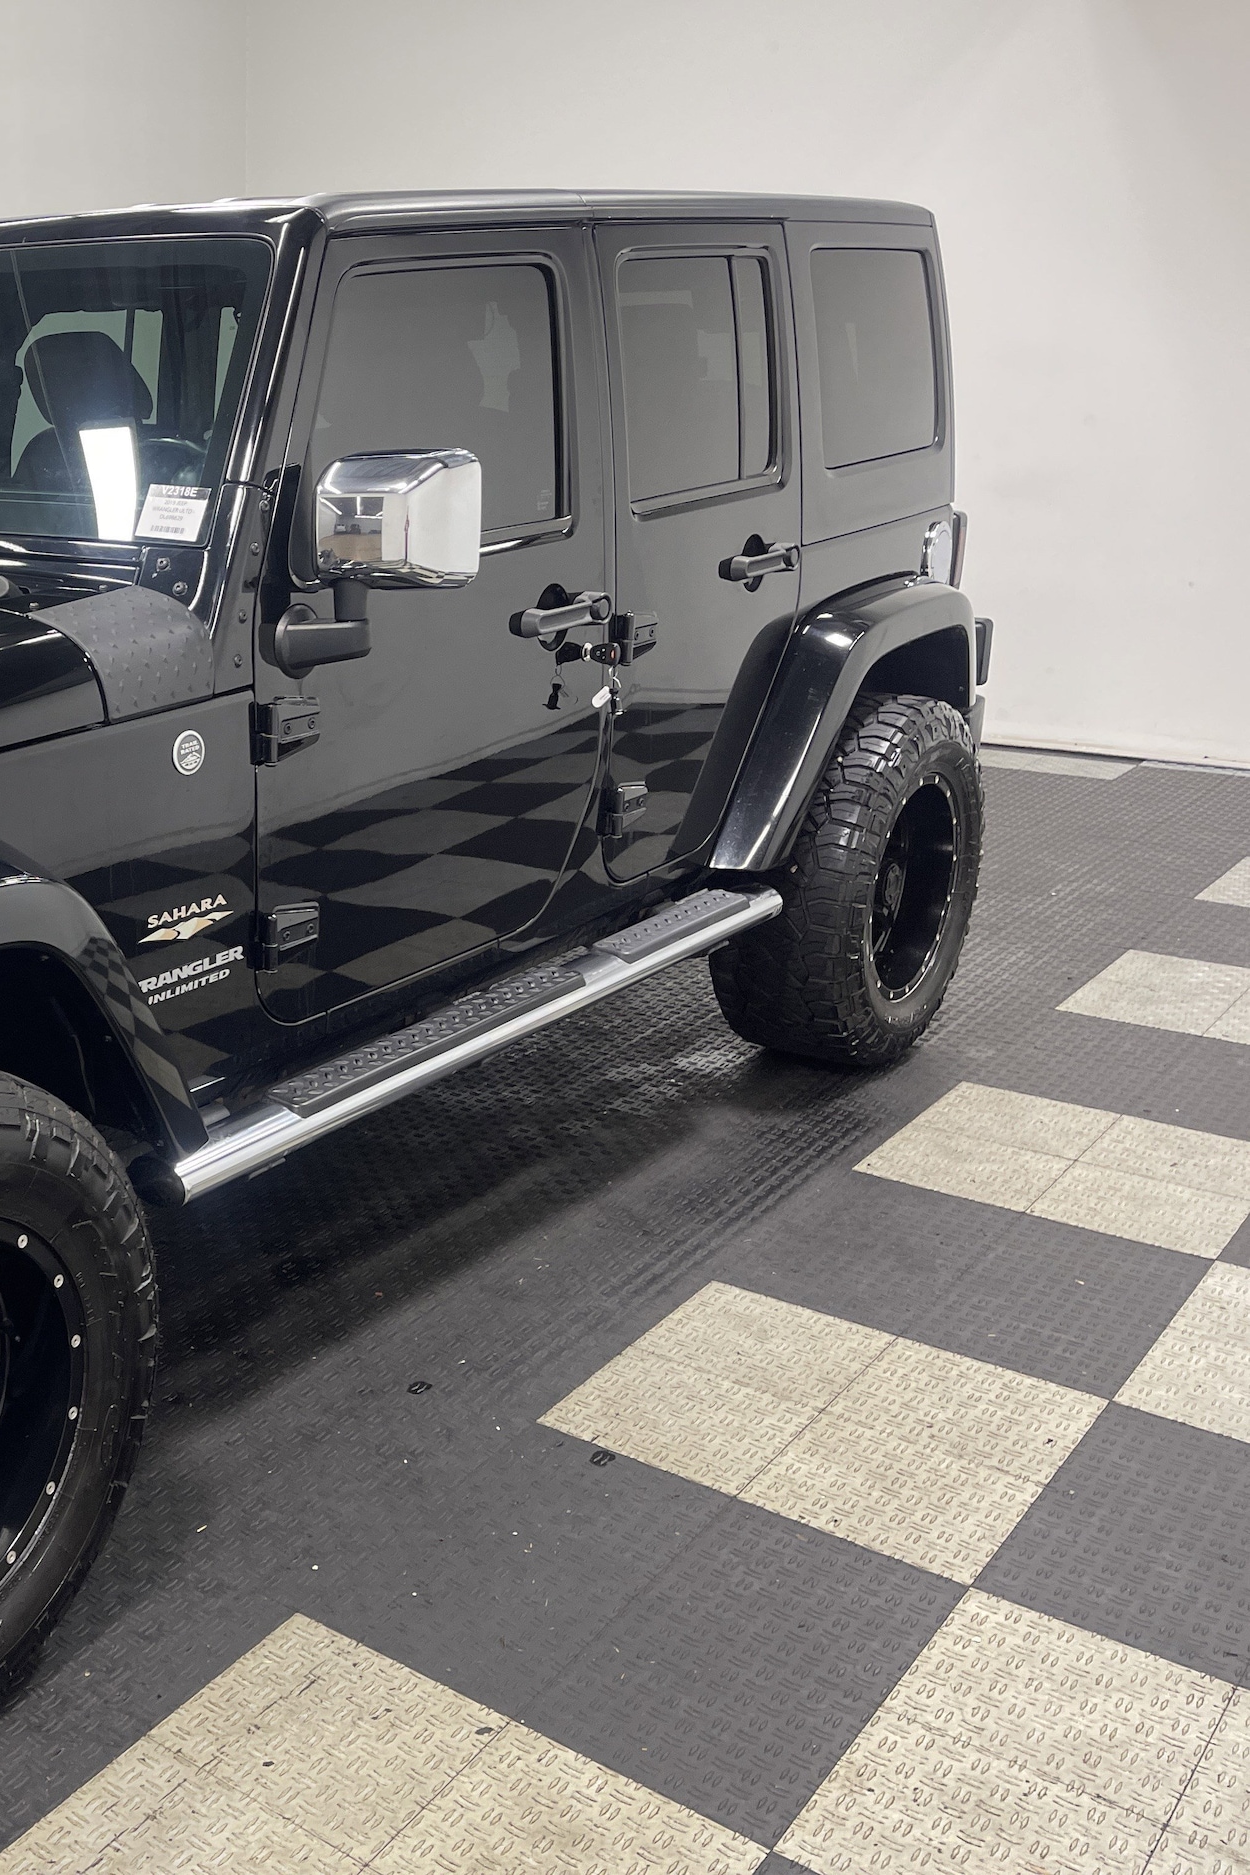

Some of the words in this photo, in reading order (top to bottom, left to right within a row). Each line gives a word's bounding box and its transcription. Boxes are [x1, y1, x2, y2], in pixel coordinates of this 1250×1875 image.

[161, 486, 198, 497] V2318E
[147, 894, 228, 929] SAHARA
[138, 945, 245, 993] RANGLER
